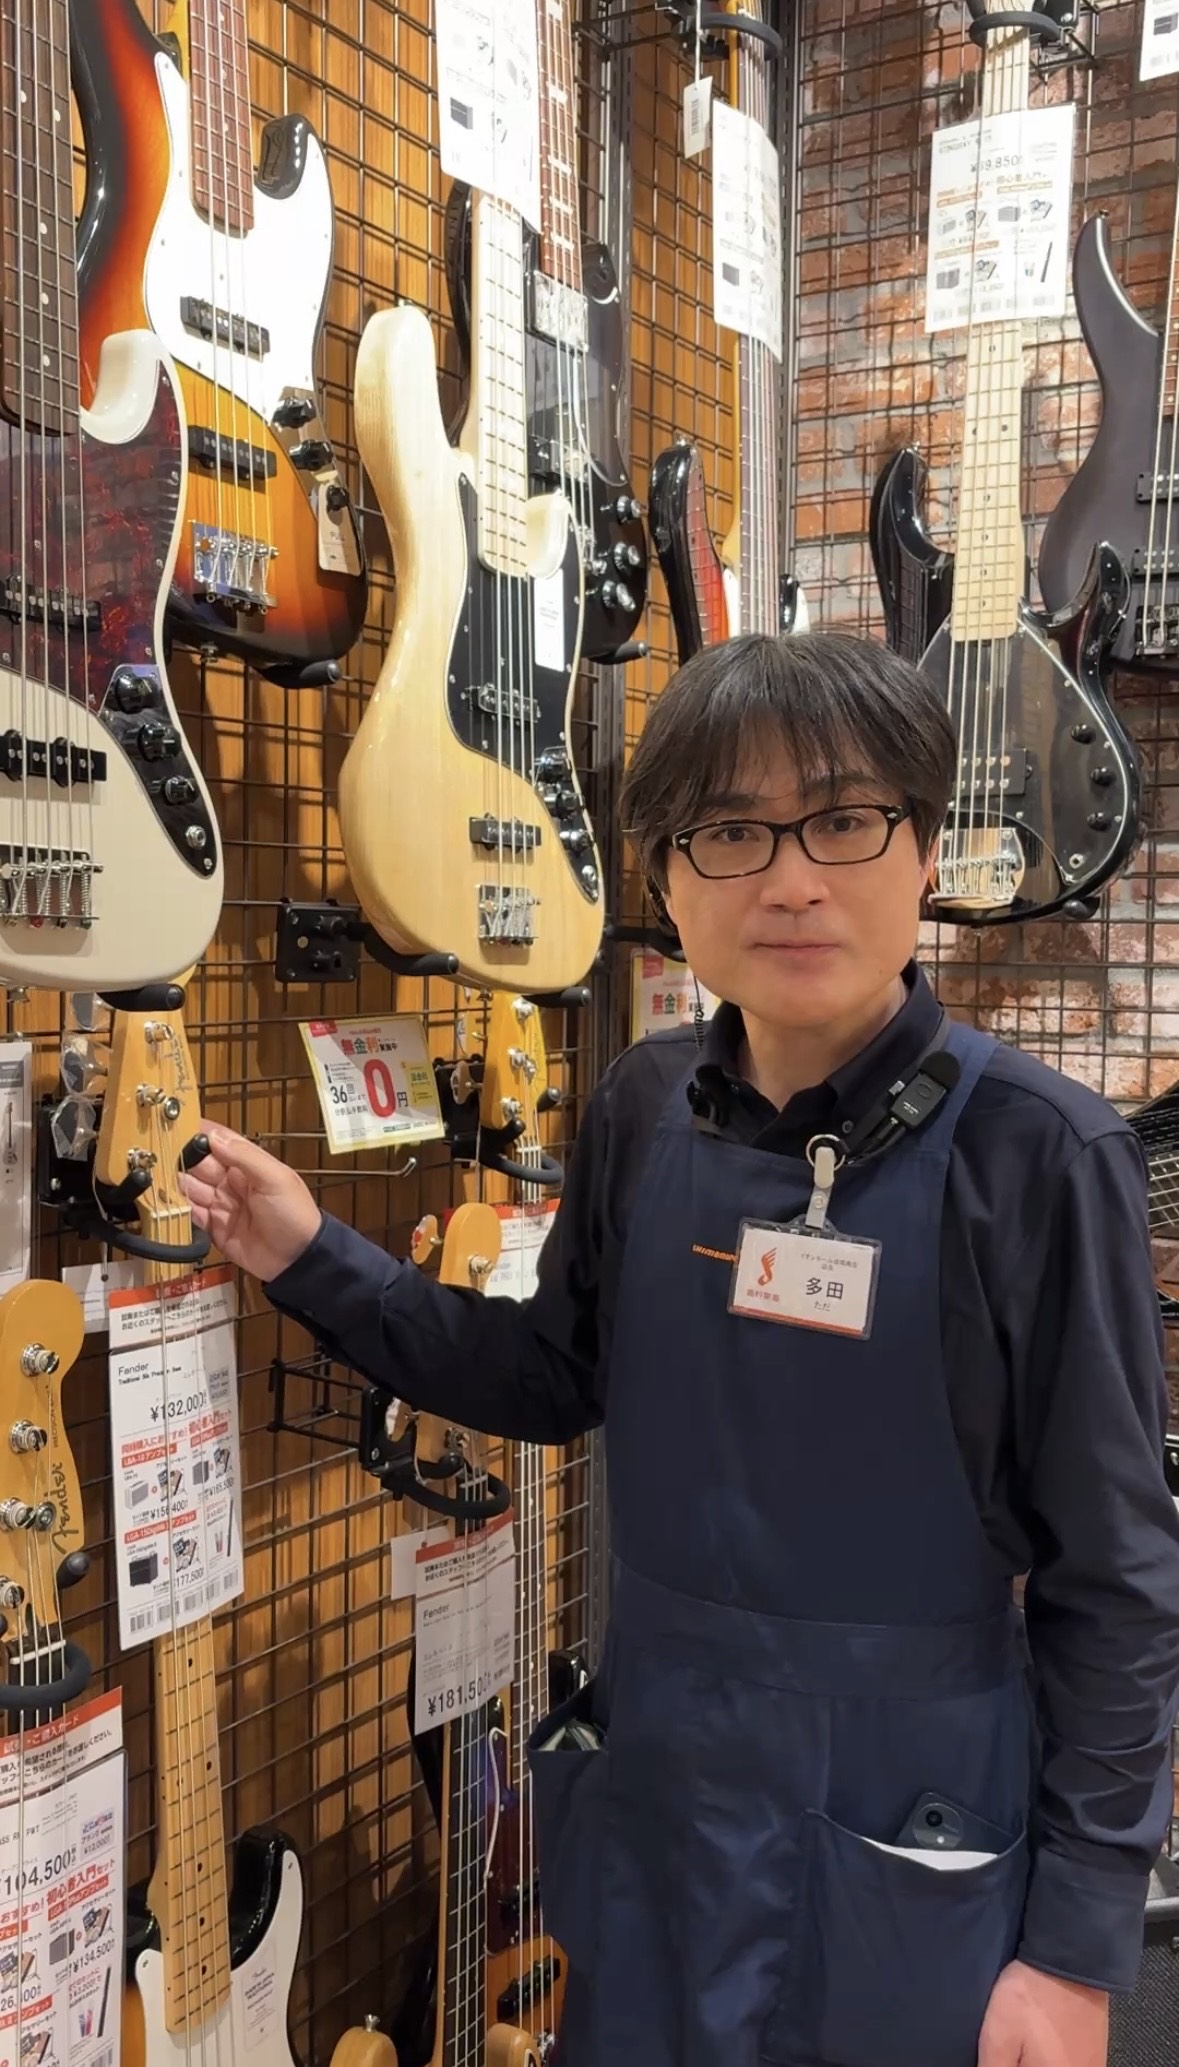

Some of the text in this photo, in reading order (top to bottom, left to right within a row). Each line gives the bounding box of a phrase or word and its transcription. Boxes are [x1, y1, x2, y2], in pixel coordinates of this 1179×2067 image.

[363, 1058, 396, 1118] 0
[805, 1276, 844, 1300] 多田
[118, 1361, 150, 1376] Fender
[423, 1604, 449, 1620] Fender
